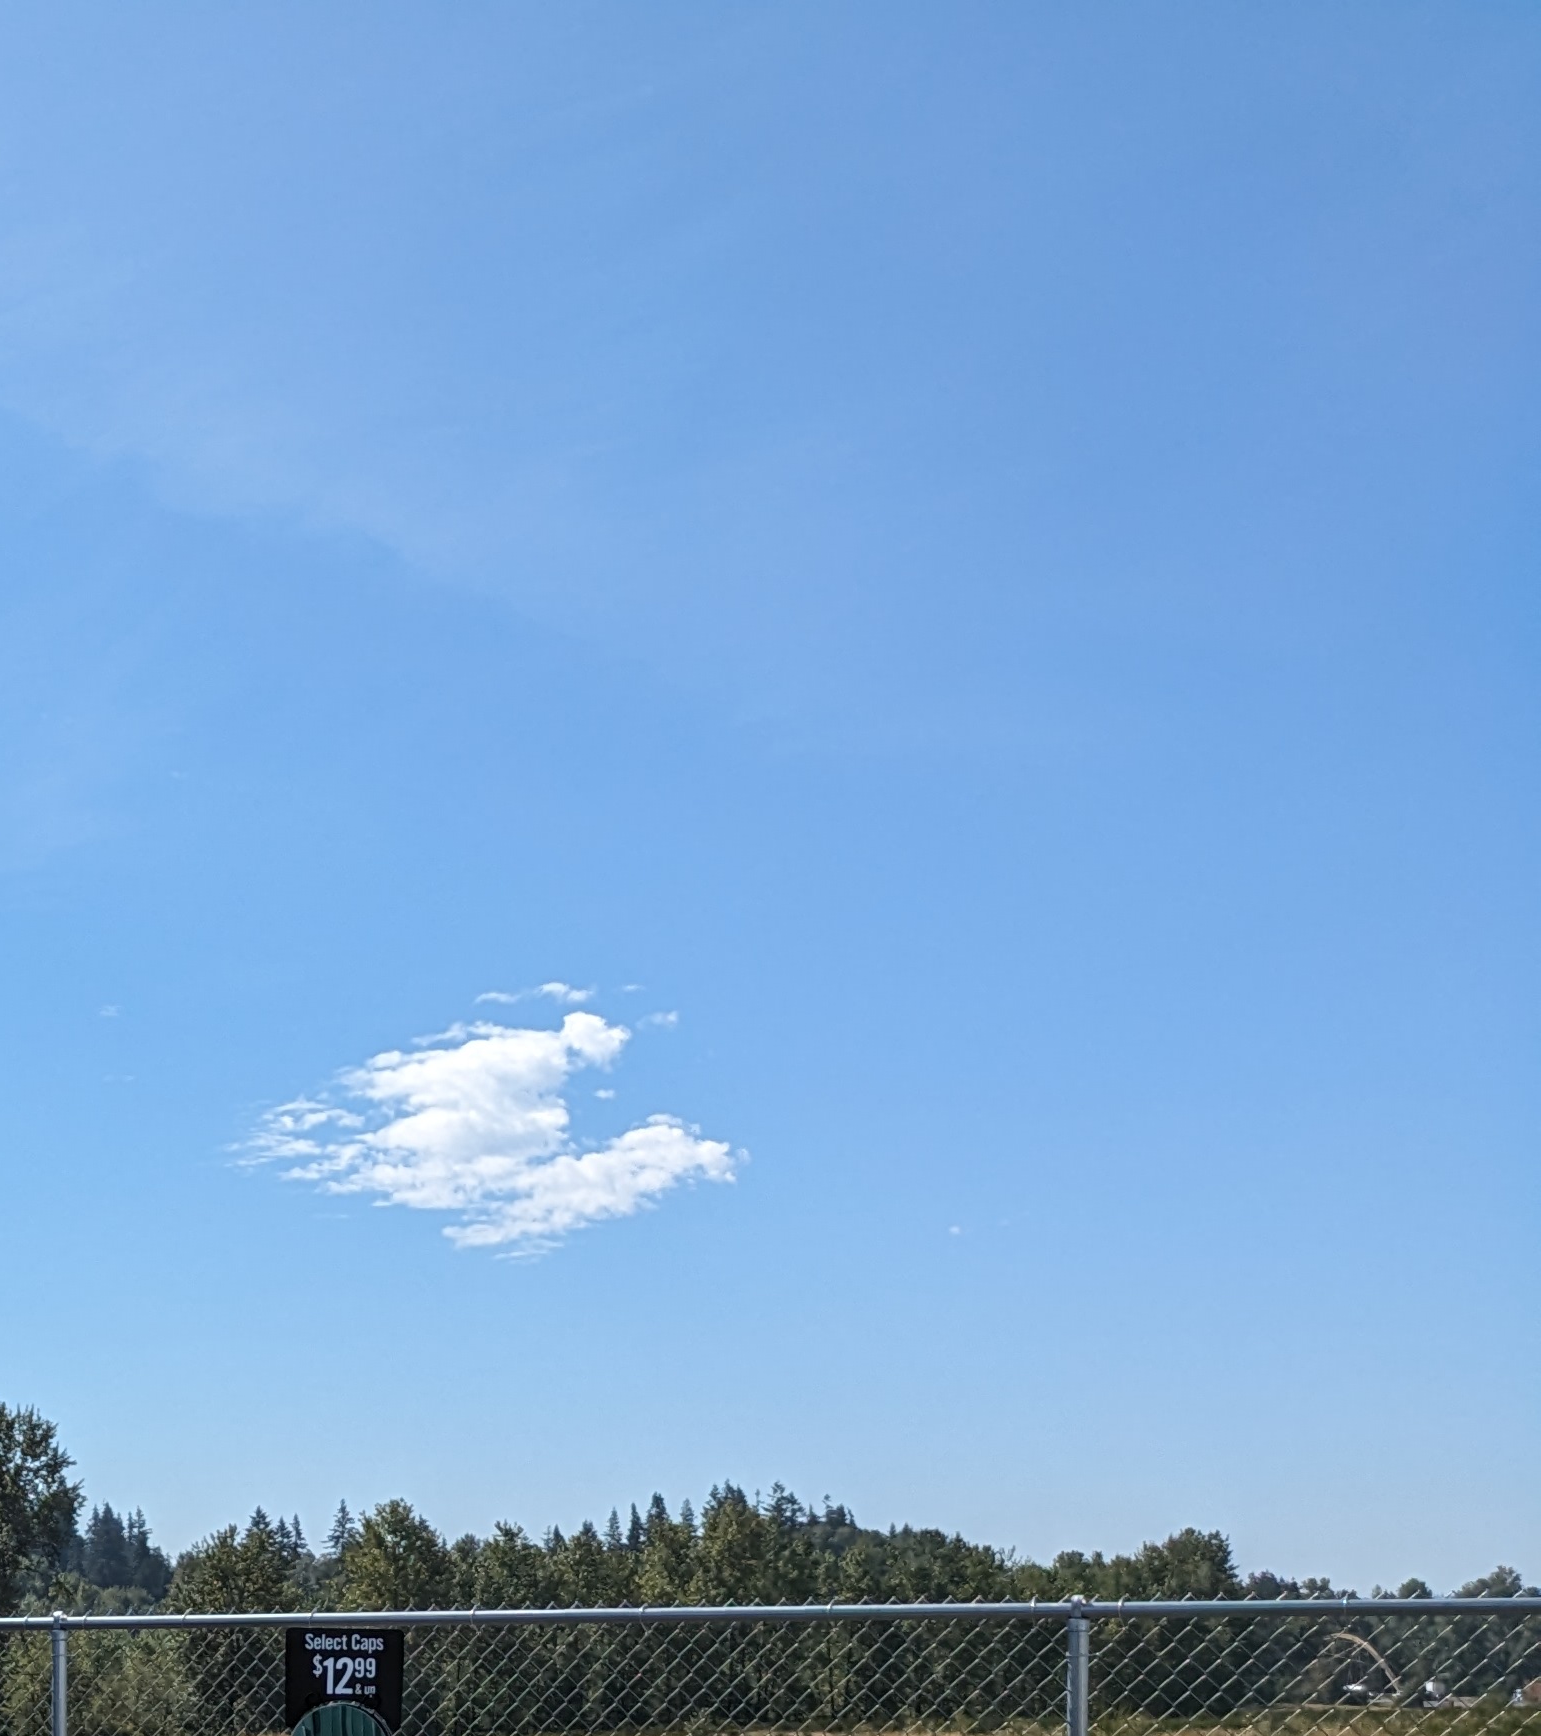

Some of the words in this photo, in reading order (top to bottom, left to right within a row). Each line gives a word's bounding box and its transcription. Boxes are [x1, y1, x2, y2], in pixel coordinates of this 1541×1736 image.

[304, 1633, 348, 1651] Select
[351, 1633, 384, 1654] Caps
[363, 1685, 377, 1698] up
